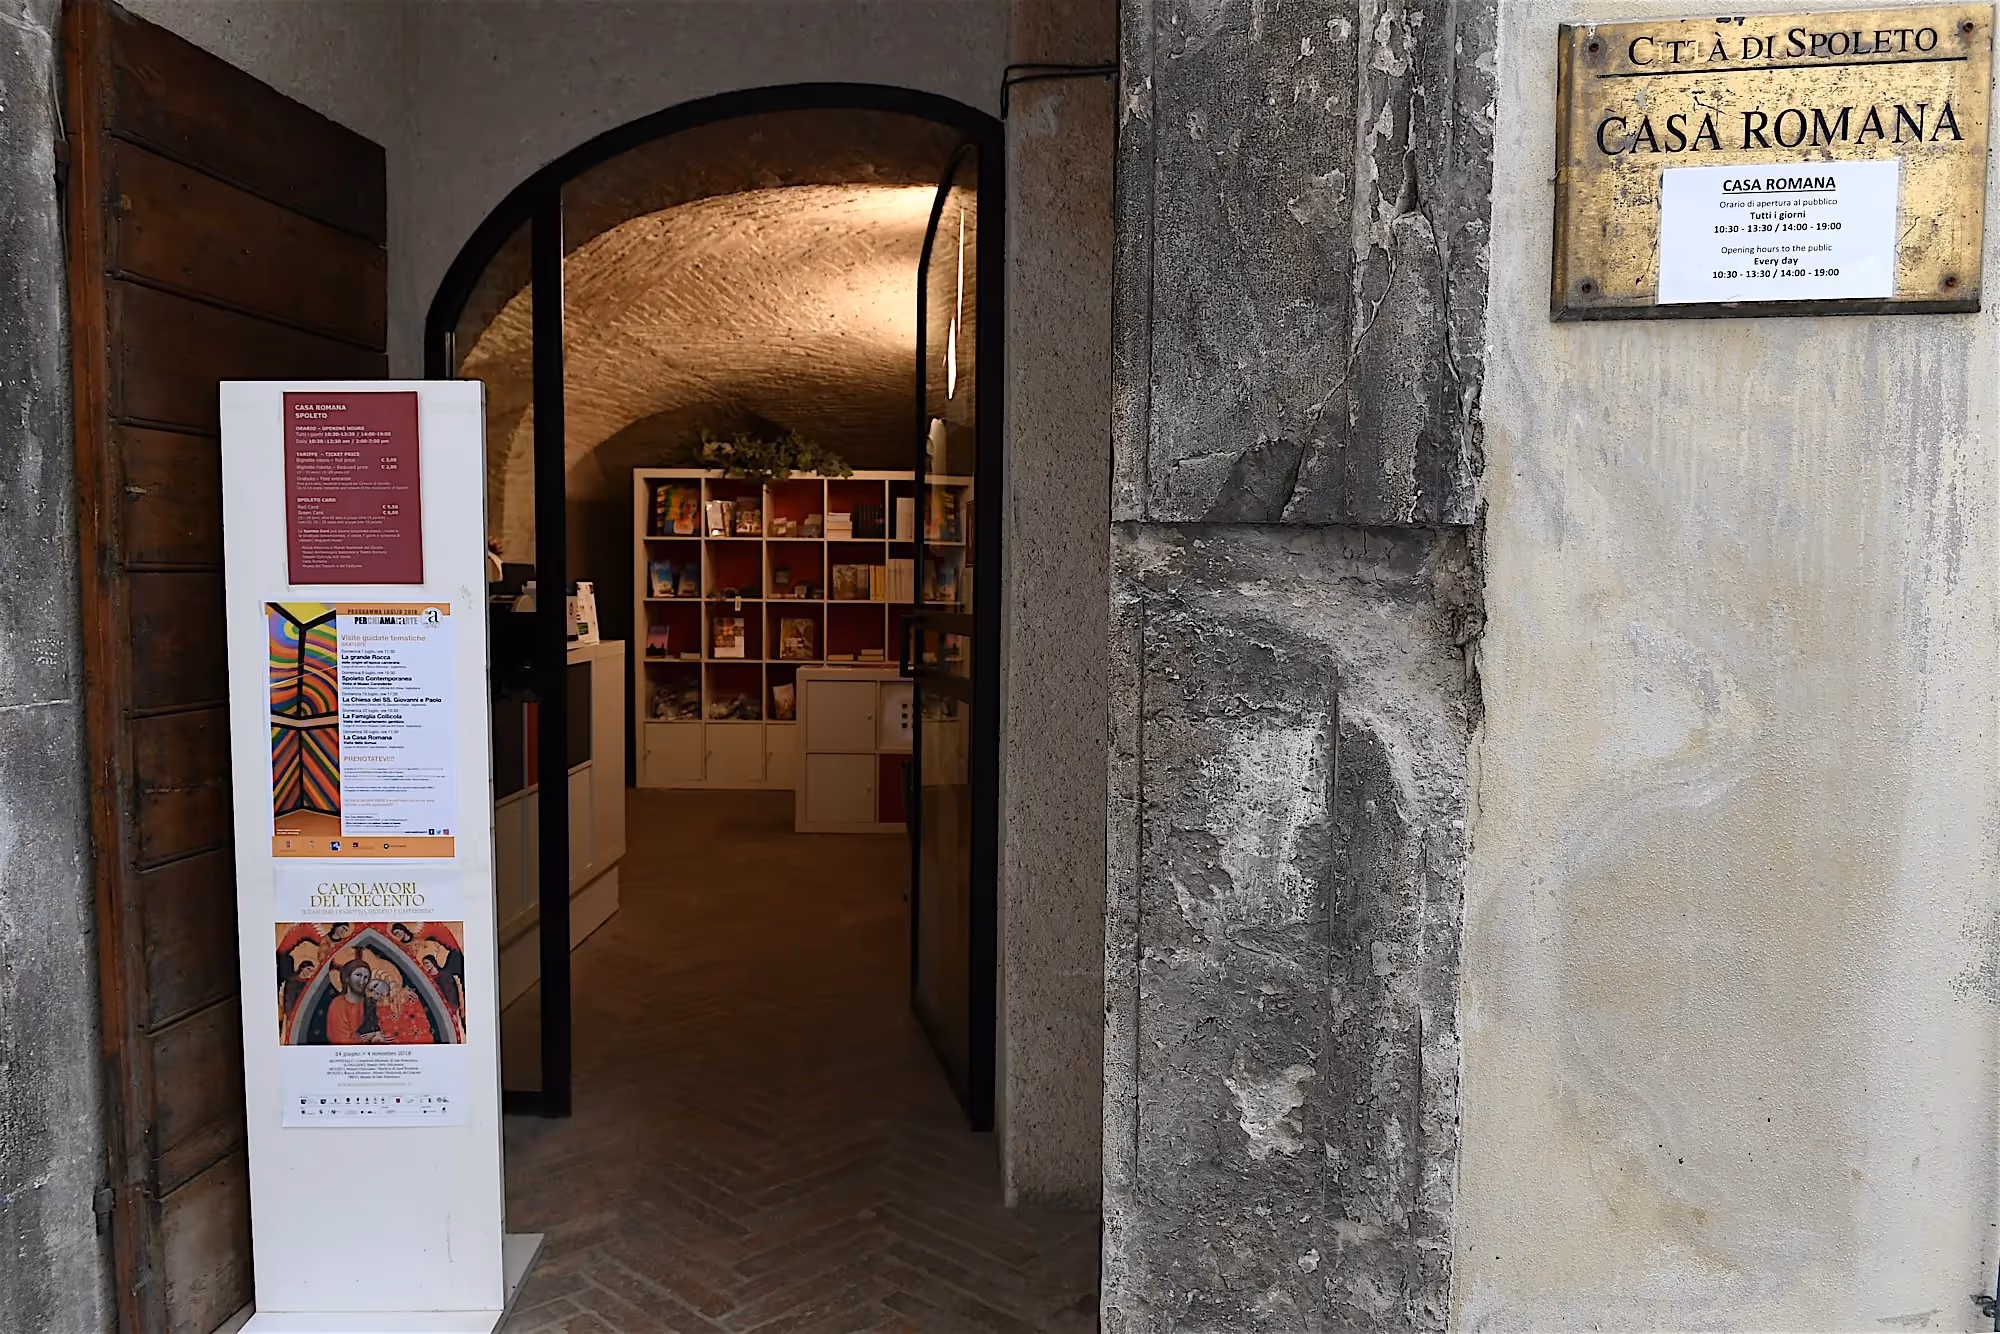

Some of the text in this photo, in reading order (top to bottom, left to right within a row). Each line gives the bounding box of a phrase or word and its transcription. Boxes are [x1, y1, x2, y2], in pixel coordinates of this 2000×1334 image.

[1741, 36, 1775, 60] DI
[1786, 27, 1938, 59] SPOLETO
[1596, 103, 1965, 156] CASA ROMANA
[1723, 176, 1836, 192] CASA ROMANA
[1719, 198, 1838, 209] Orario di apertura al pubblico
[1750, 211, 1772, 220] Tutti
[1779, 210, 1806, 221] giorni
[1714, 225, 1739, 234] 10:30
[1747, 224, 1773, 233] 13:30
[1775, 223, 1780, 233] /
[1782, 222, 1808, 232] 14:00
[1816, 222, 1842, 231] 19:00
[1721, 246, 1755, 255] Opening
[1757, 245, 1779, 253] hours
[1808, 244, 1833, 254] public
[1754, 256, 1799, 267] Every day
[1712, 270, 1738, 279] 10:30
[1746, 269, 1771, 278] 13:30
[1773, 269, 1778, 279] /
[1781, 269, 1806, 277] 14:00
[1814, 268, 1840, 277] 19:00
[317, 882, 417, 895] CAPOLAVORI
[310, 894, 425, 908] DEL TRECENTO
